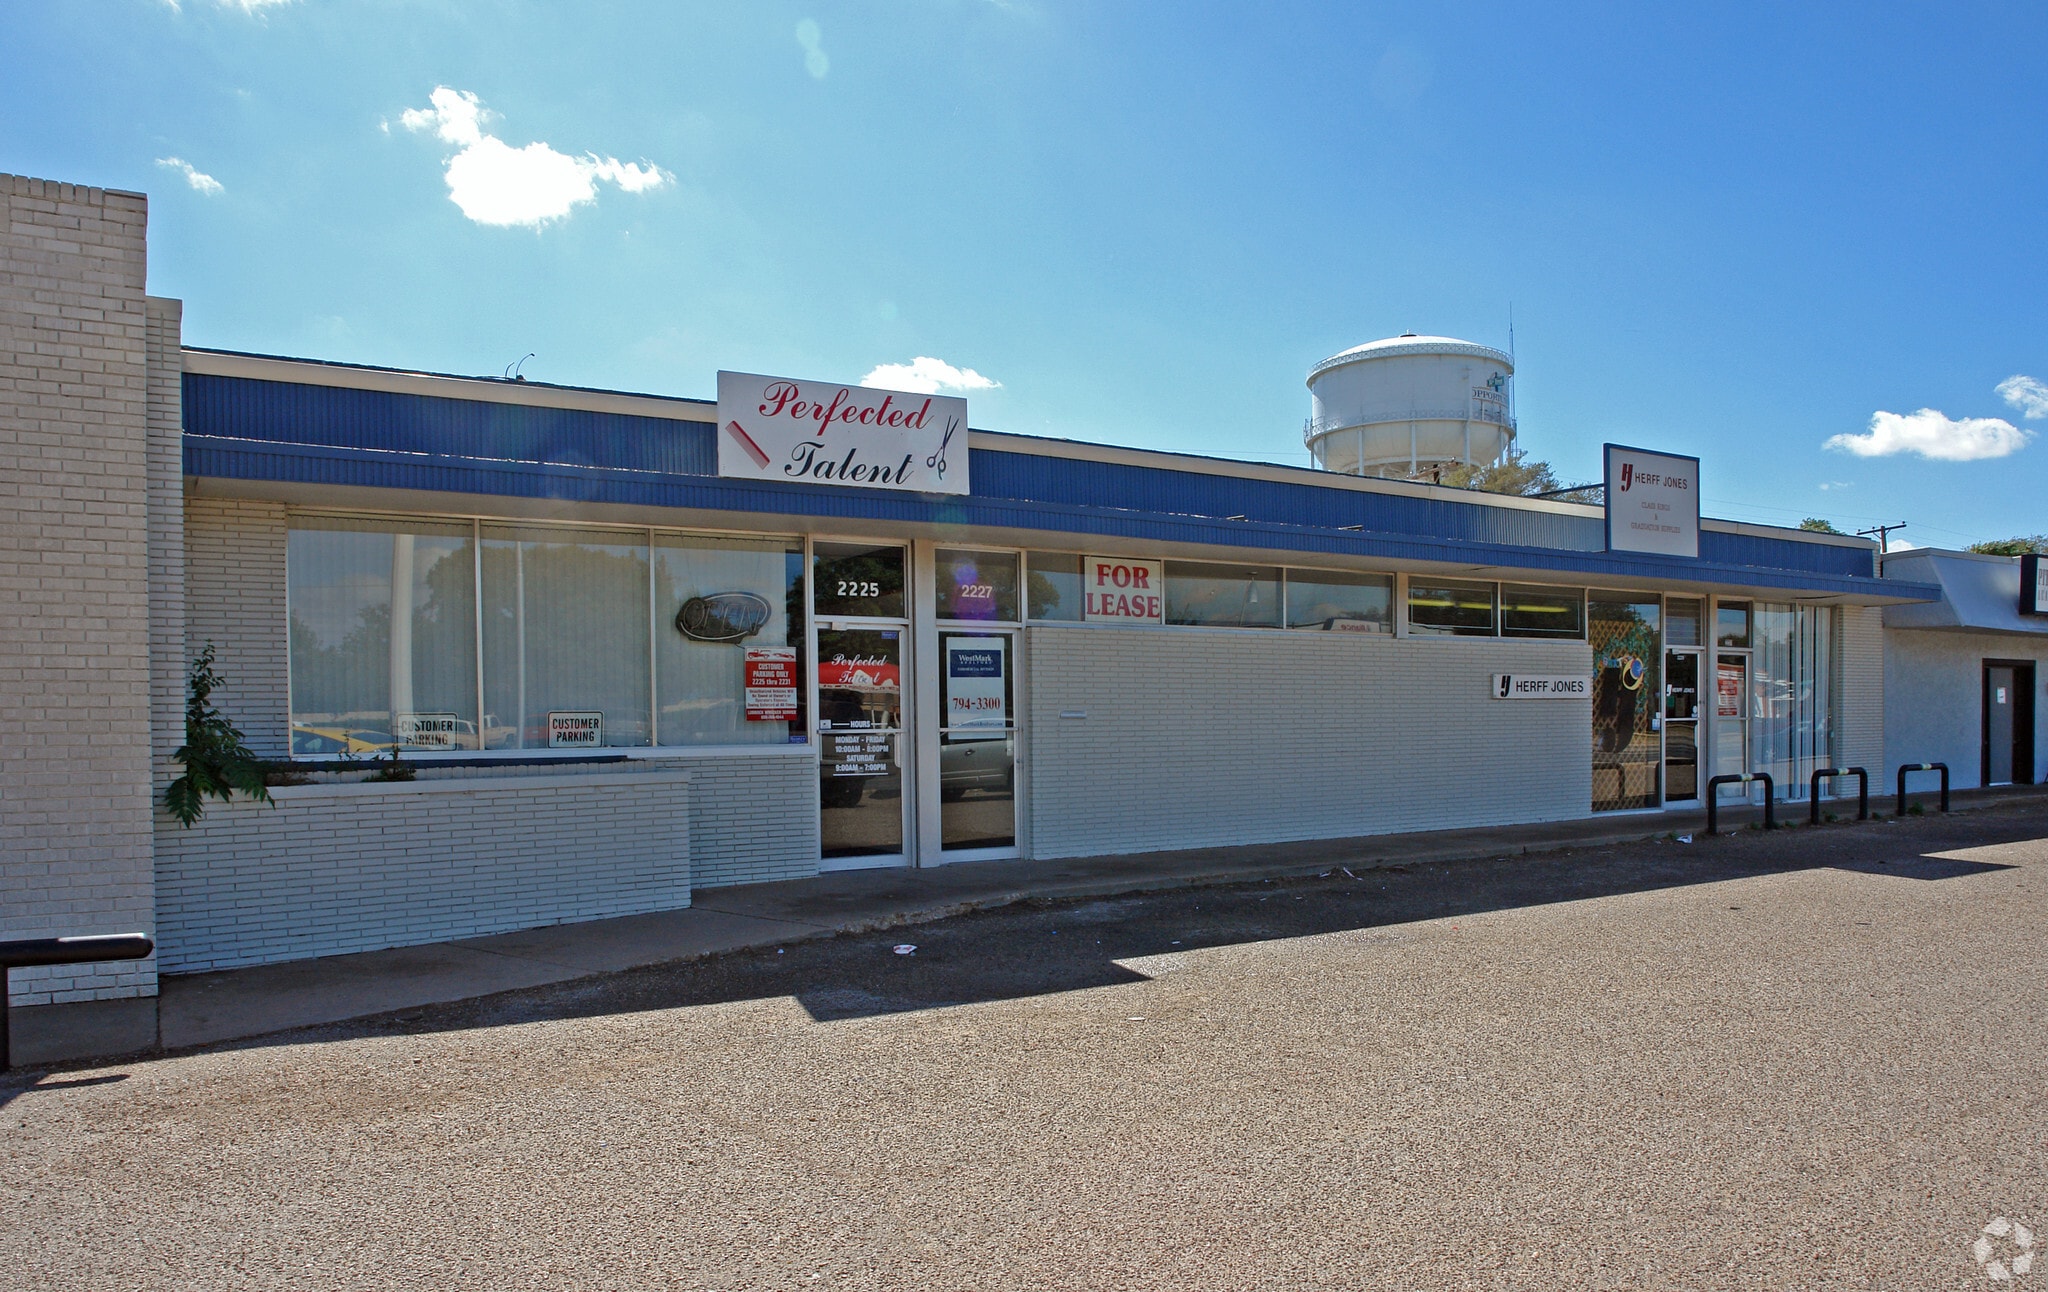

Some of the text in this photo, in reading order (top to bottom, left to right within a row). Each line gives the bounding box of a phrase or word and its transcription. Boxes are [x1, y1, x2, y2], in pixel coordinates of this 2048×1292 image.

[759, 381, 934, 436] Perfected
[784, 441, 914, 485] Talent
[1635, 472, 1660, 485] HERFF
[1663, 476, 1688, 490] JONES
[1096, 563, 1149, 589] FOR
[837, 581, 880, 597] 2225
[961, 585, 993, 598] 2227
[1086, 592, 1160, 618] LEASE
[831, 653, 887, 671] Perfected
[958, 654, 992, 662] WestMark
[1516, 680, 1549, 693] HERFF
[1551, 680, 1584, 694] JONES
[952, 697, 1001, 710] 794-3300
[401, 720, 453, 733] CUSTOMER
[552, 718, 600, 731] CUSTOMER
[850, 720, 871, 728] HOURS
[406, 734, 448, 746] PARKING
[556, 731, 595, 744] PARKING
[835, 735, 860, 743] MONDAY
[865, 735, 886, 743] FRIDAY
[835, 745, 861, 753] 10:00AM
[846, 754, 876, 762] SATURDAY
